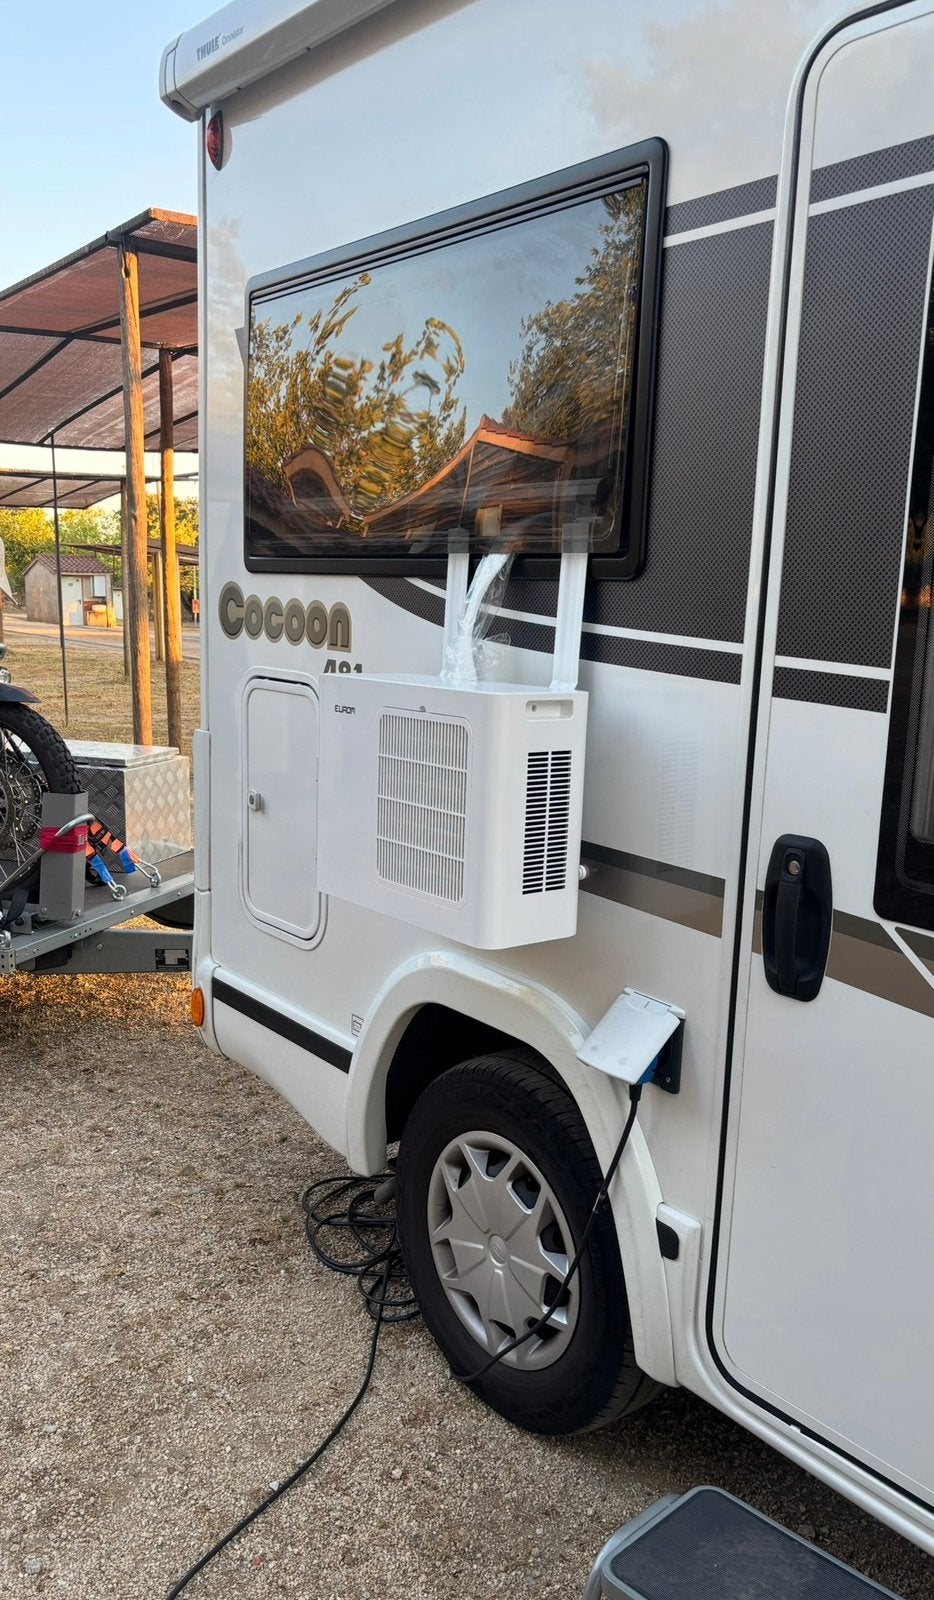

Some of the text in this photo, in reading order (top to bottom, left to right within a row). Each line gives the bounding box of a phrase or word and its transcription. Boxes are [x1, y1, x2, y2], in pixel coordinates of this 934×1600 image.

[196, 35, 220, 61] THULE
[219, 581, 352, 653] Cocoon
[334, 704, 356, 716] EUROM
